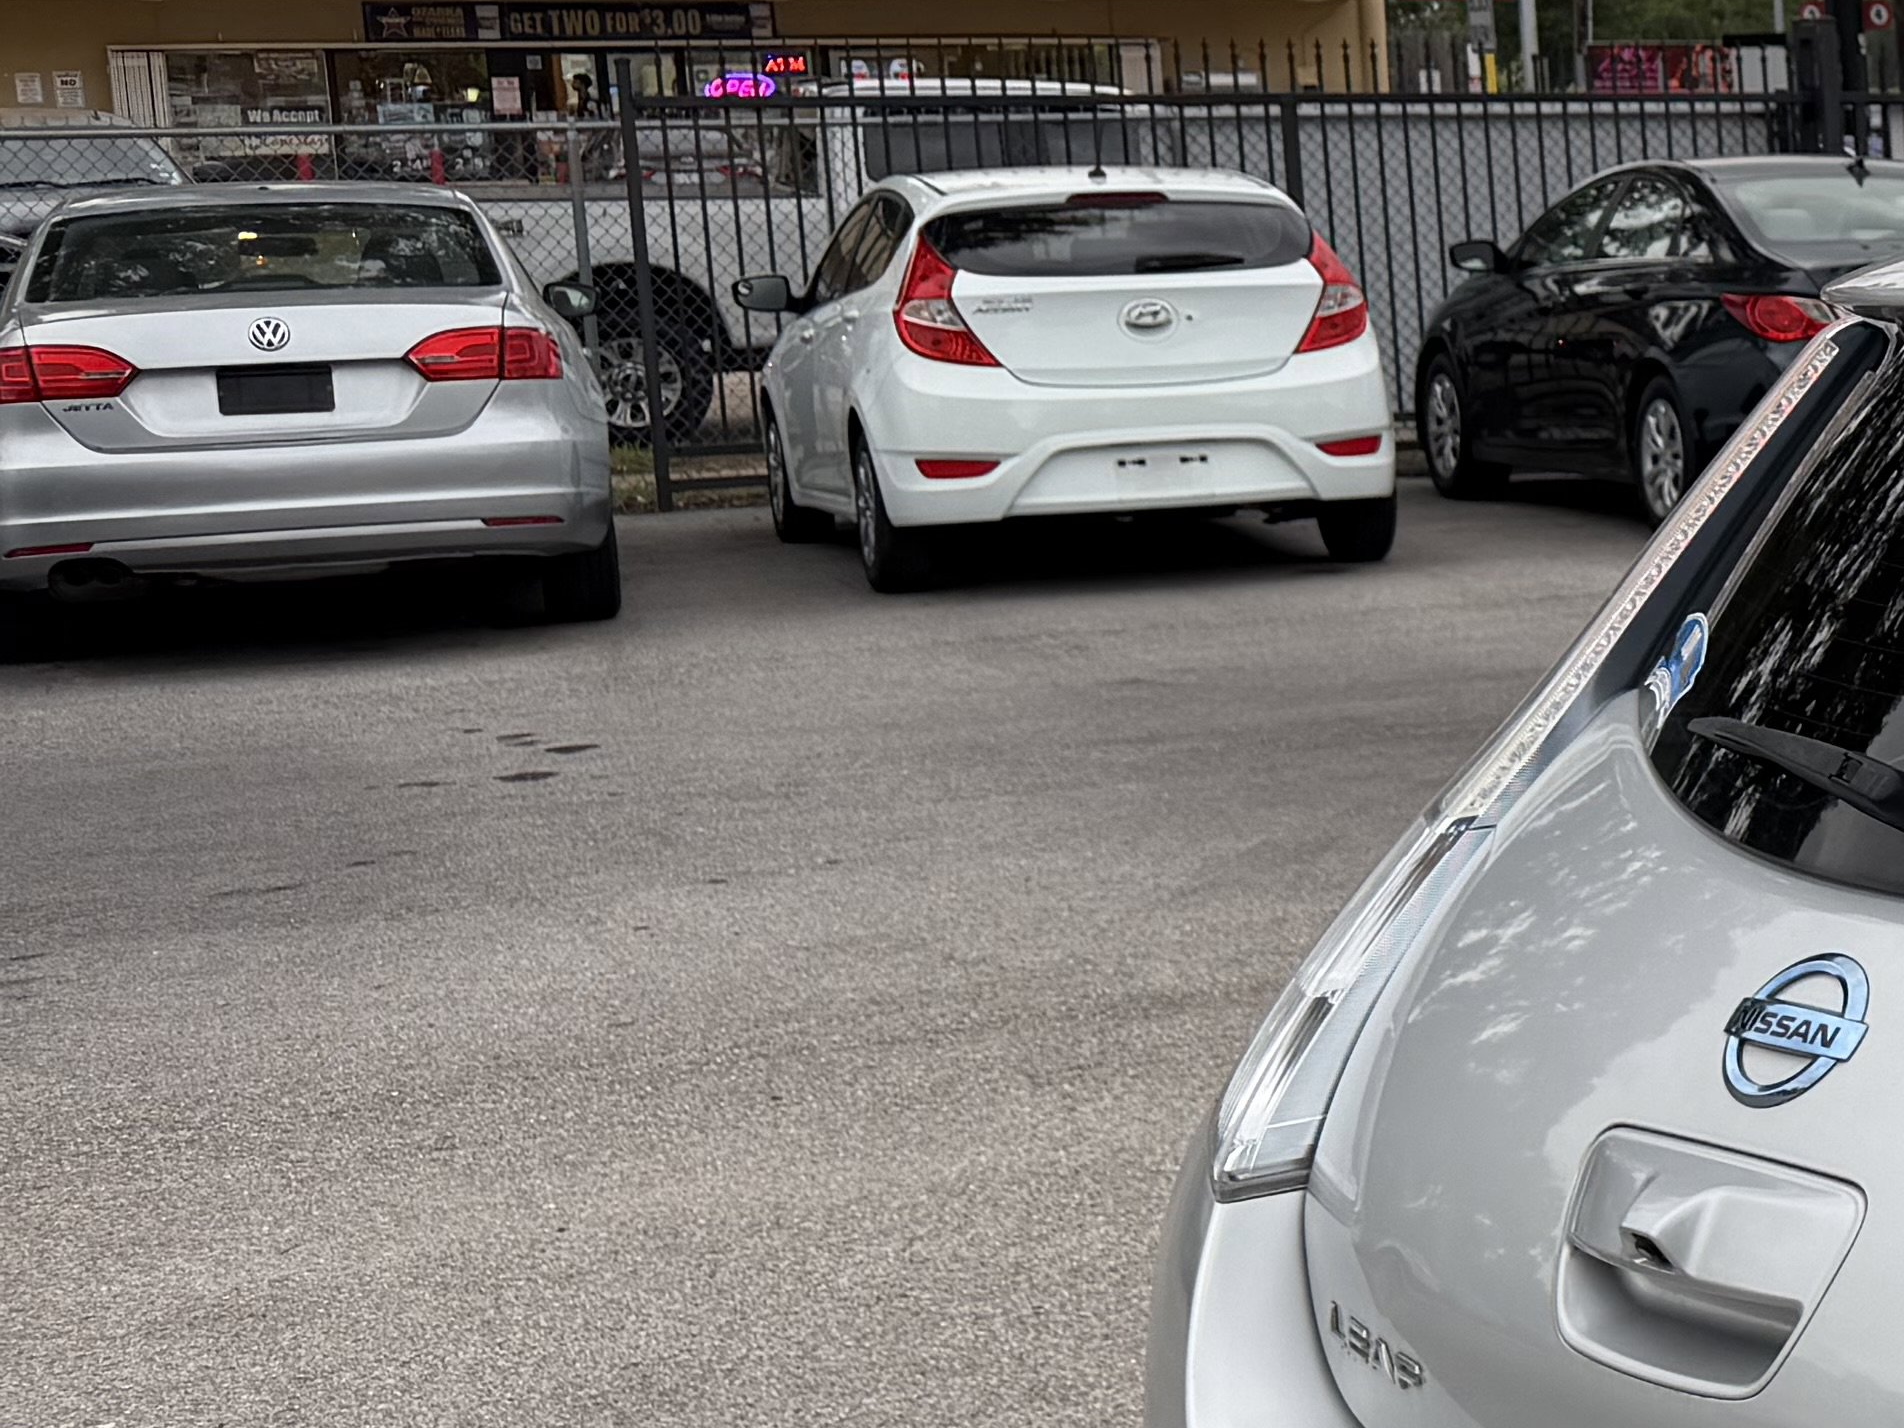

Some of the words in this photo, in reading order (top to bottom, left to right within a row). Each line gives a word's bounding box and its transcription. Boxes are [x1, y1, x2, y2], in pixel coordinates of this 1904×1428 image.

[509, 11, 545, 34] GET
[547, 9, 600, 37] TWO
[604, 11, 641, 34] FOR
[643, 8, 702, 36] $3.00
[272, 109, 320, 124] Accept
[1736, 1003, 1842, 1049] NISSAN
[1329, 1300, 1426, 1391] LEAF
